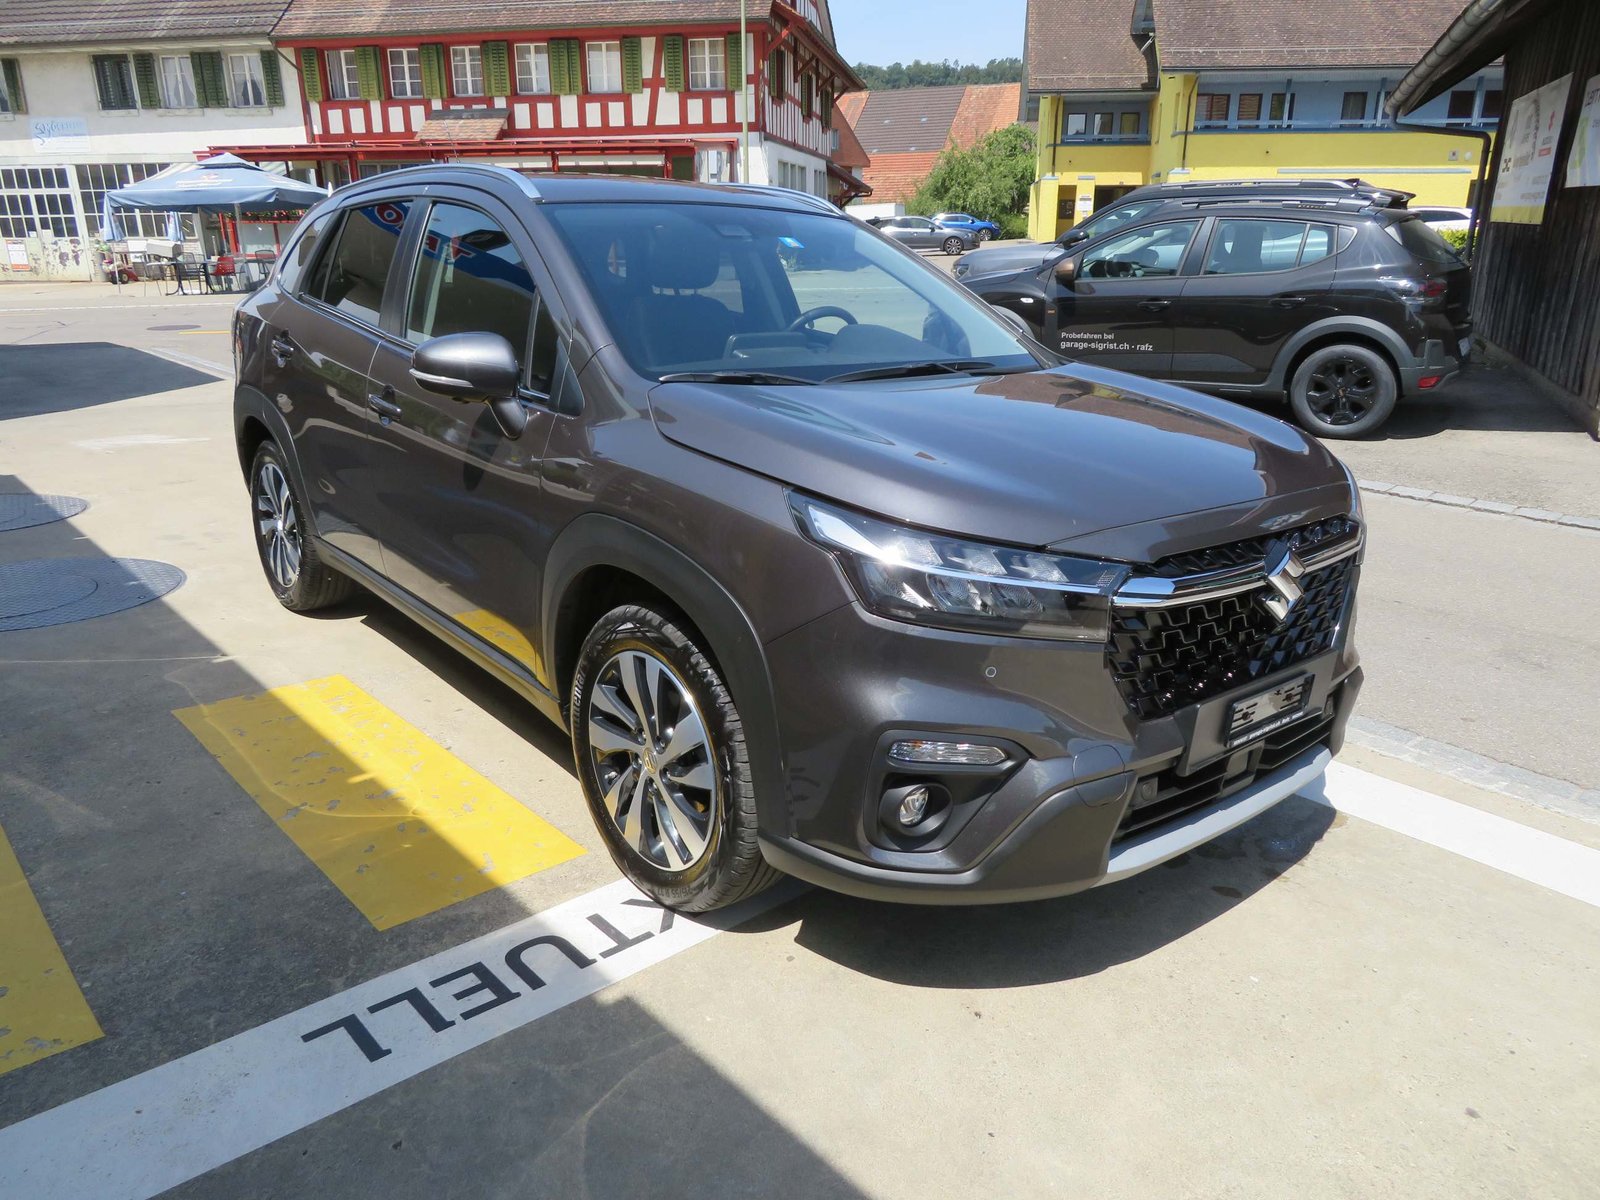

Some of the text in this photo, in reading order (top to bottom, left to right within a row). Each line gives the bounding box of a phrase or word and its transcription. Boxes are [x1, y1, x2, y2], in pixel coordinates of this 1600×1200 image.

[1061, 332, 1102, 340] Probefahren
[1060, 340, 1130, 351] garage-sigrist.ch
[1136, 343, 1154, 352] rafz
